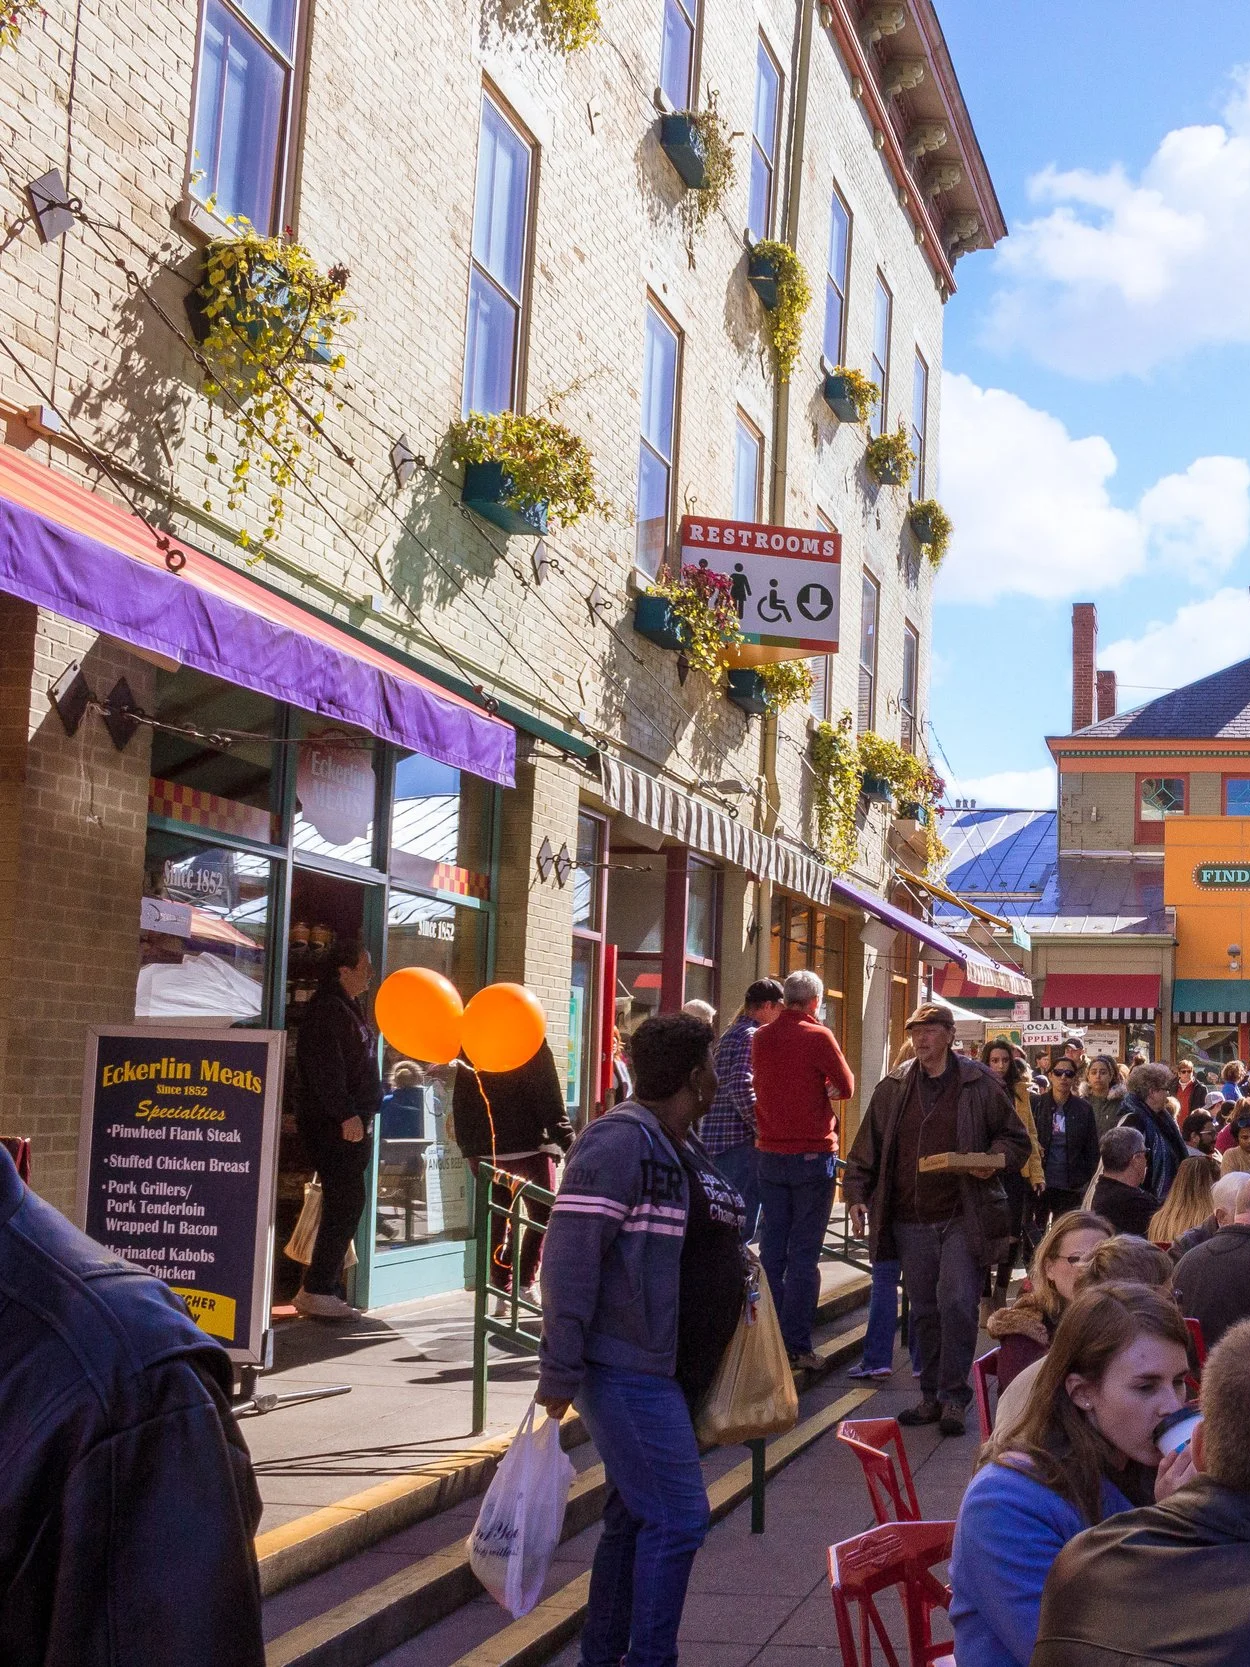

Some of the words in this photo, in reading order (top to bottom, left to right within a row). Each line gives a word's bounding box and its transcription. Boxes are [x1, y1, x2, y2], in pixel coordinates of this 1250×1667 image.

[689, 524, 835, 557] RESTROOMS
[163, 859, 194, 886] Since
[196, 868, 223, 895] 1852
[438, 921, 455, 942] 1852
[102, 1057, 192, 1088] Eckerlin
[200, 1059, 262, 1094] Meats
[156, 1084, 182, 1095] Since
[184, 1085, 208, 1096] 1852
[135, 1099, 226, 1121] Specialties
[169, 1126, 204, 1142] Flank
[206, 1127, 242, 1143] Steak
[109, 1153, 152, 1169] Stuffed
[156, 1155, 206, 1172] Chicken
[209, 1157, 250, 1173] Breast
[108, 1180, 137, 1195] Pork
[140, 1181, 193, 1200] Grillers/
[106, 1199, 136, 1213] Pork
[140, 1200, 206, 1217] Tenderloin
[105, 1217, 159, 1235] Wrapped
[163, 1221, 175, 1234] In
[179, 1221, 218, 1236] Bacon
[169, 1248, 215, 1263] Kabobs
